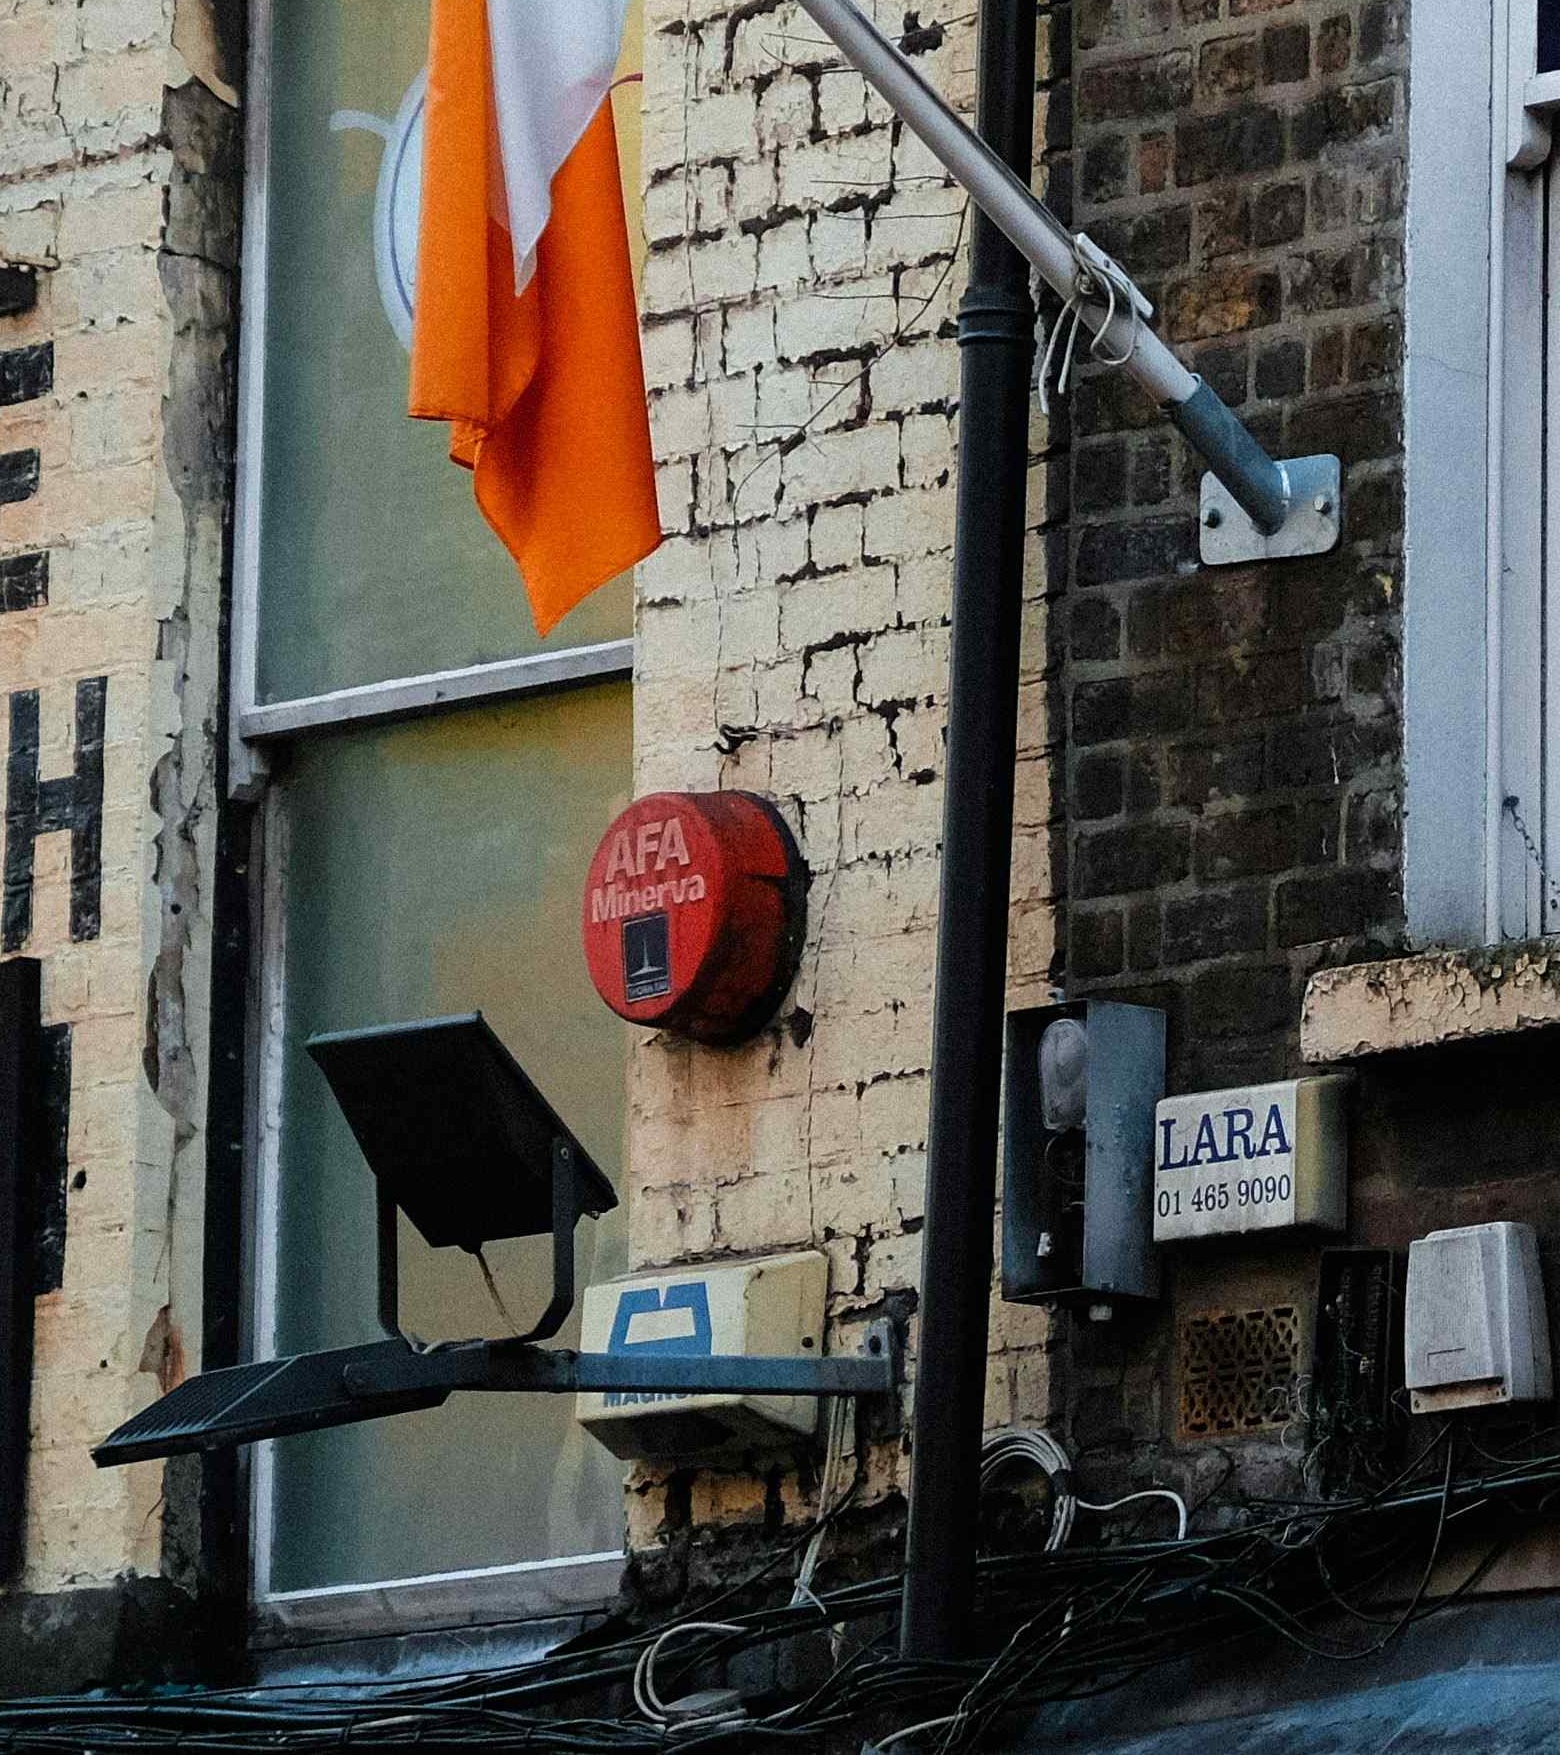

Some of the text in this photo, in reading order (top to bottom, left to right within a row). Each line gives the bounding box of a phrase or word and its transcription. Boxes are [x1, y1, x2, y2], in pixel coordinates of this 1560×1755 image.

[605, 817, 690, 883] AFA
[592, 874, 705, 922] Minerva
[1158, 1104, 1292, 1171] LARA
[1158, 1174, 1291, 1217] 01 465 9090
